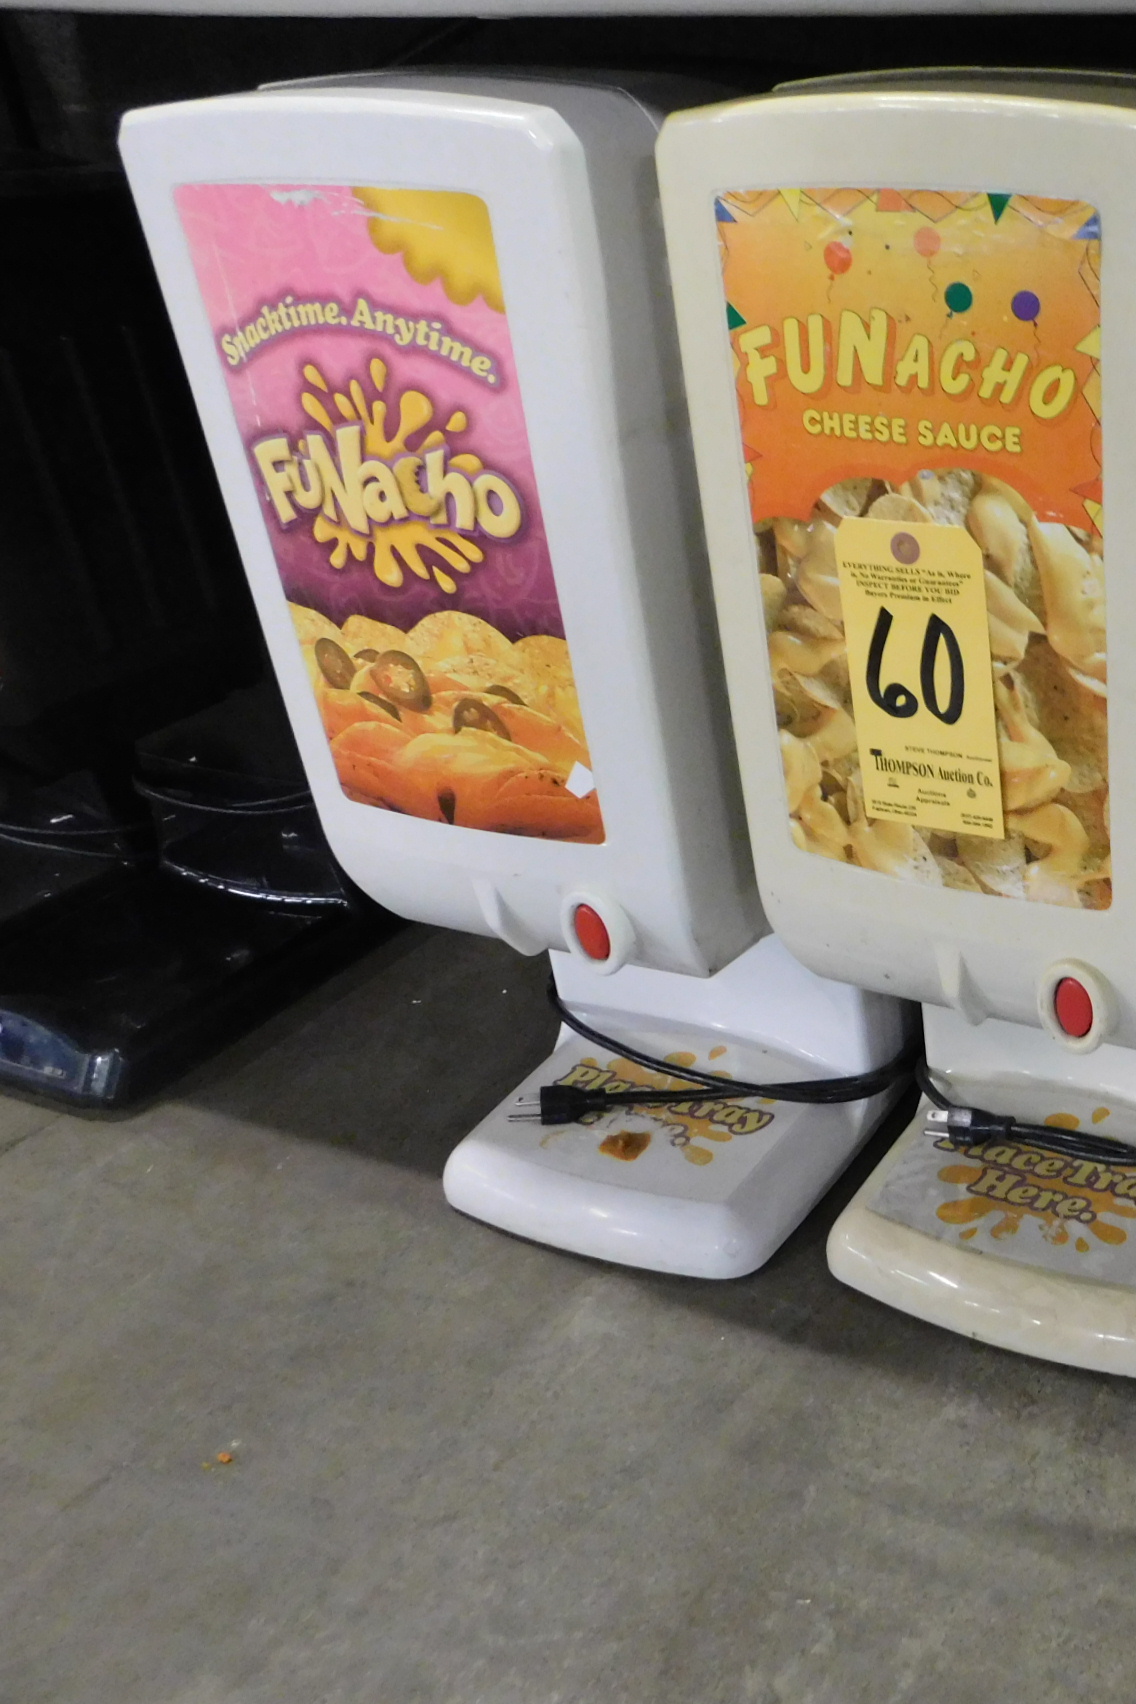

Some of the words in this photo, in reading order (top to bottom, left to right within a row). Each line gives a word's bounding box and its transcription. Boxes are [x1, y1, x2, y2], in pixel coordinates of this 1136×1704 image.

[221, 296, 347, 366] Snacktime.
[351, 298, 497, 383] Anytime.
[739, 307, 1077, 420] FUNACHO
[802, 408, 908, 444] CHEESE
[917, 419, 1023, 453] SAUCE
[842, 561, 894, 573] EVERYTHING
[895, 566, 921, 576] SELLS
[856, 579, 889, 590] INSPECT
[891, 583, 922, 594] BEFORE
[925, 587, 942, 595] YOU
[945, 588, 960, 596] BID
[866, 605, 964, 725] 60
[870, 750, 935, 779] THOMPSON
[938, 766, 975, 785] Auction
[976, 771, 994, 787] Co.
[553, 1064, 663, 1107] Pla
[933, 1138, 1068, 1179] ace
[966, 1166, 1097, 1224] Here.
